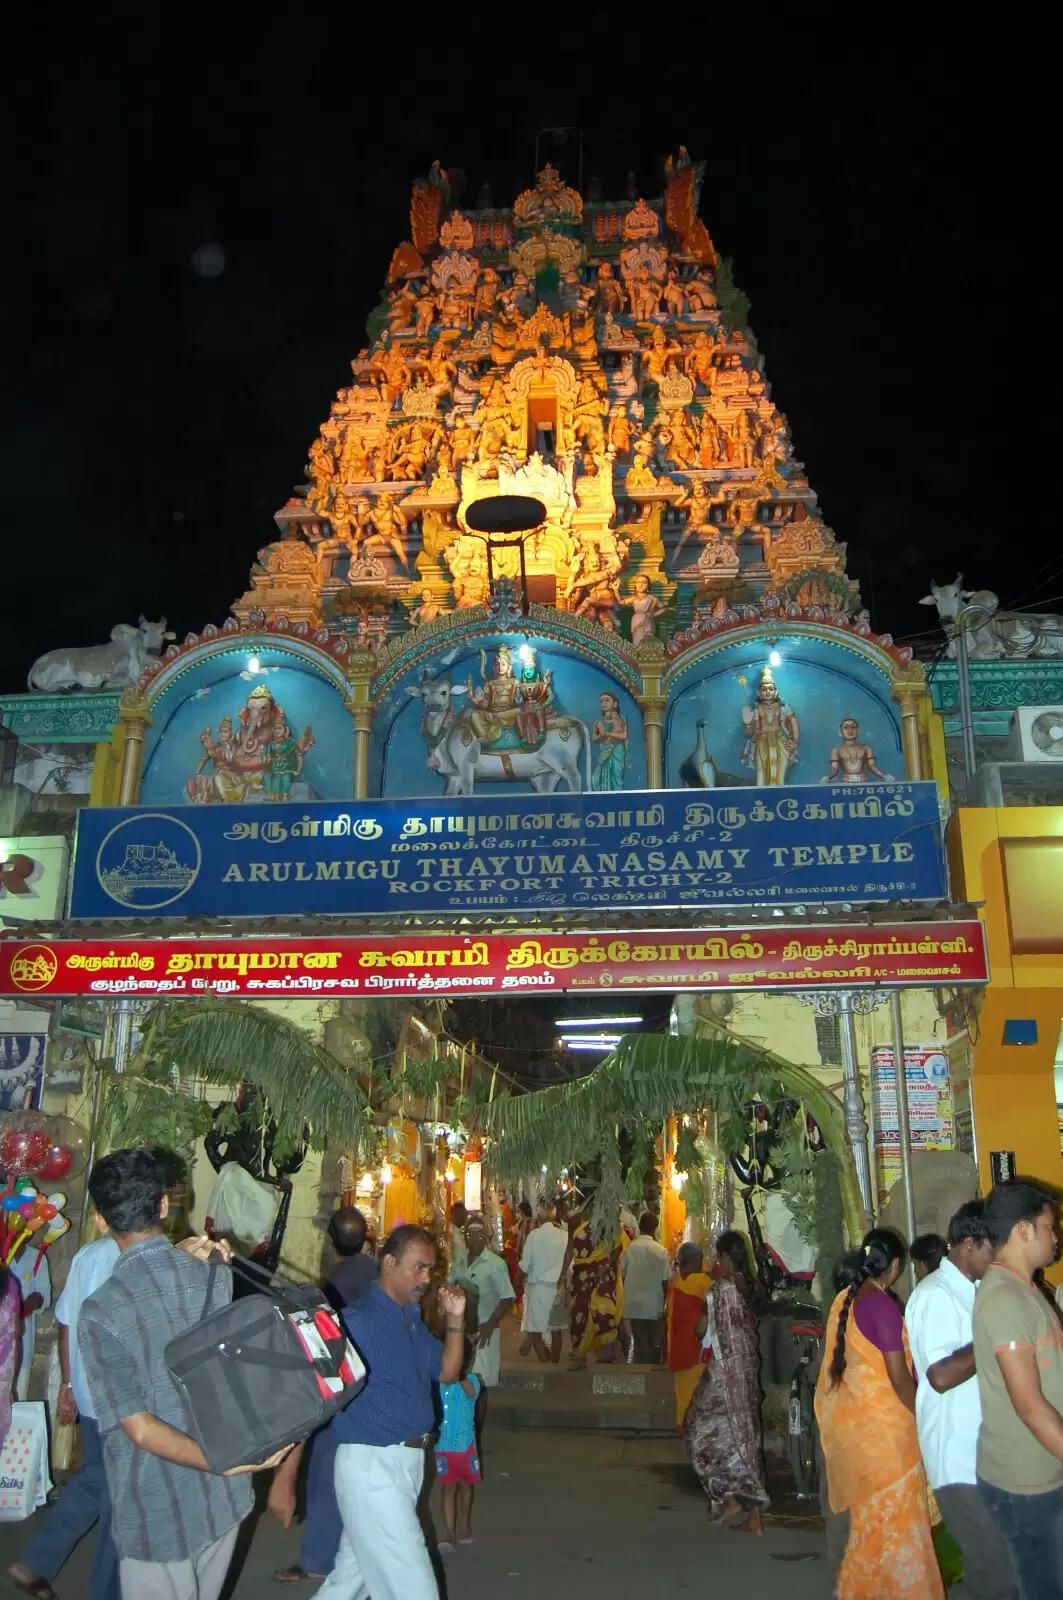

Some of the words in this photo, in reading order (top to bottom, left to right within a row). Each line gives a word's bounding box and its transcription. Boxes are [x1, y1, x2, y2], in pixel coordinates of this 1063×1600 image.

[223, 813, 384, 844] அருள்மிகு
[682, 794, 915, 831] திருக்கோயில்
[222, 859, 401, 883] ARULMIGU
[416, 848, 751, 879] THAYUMANASAMY
[768, 842, 915, 868] TEMPLE
[388, 876, 564, 894] ROCKFORT
[579, 871, 733, 889] TRICHY-2
[66, 950, 155, 971] அருள்மிகு
[165, 952, 343, 976] தாயுமான
[358, 942, 490, 968] சுவாமி
[505, 933, 764, 970] திருக்கோயில்
[90, 975, 186, 993] குழந்தைப்
[246, 974, 359, 991] சுகப்பிரசவ
[364, 972, 496, 991] பிரார்த்தனை
[500, 970, 556, 989] தலம்
